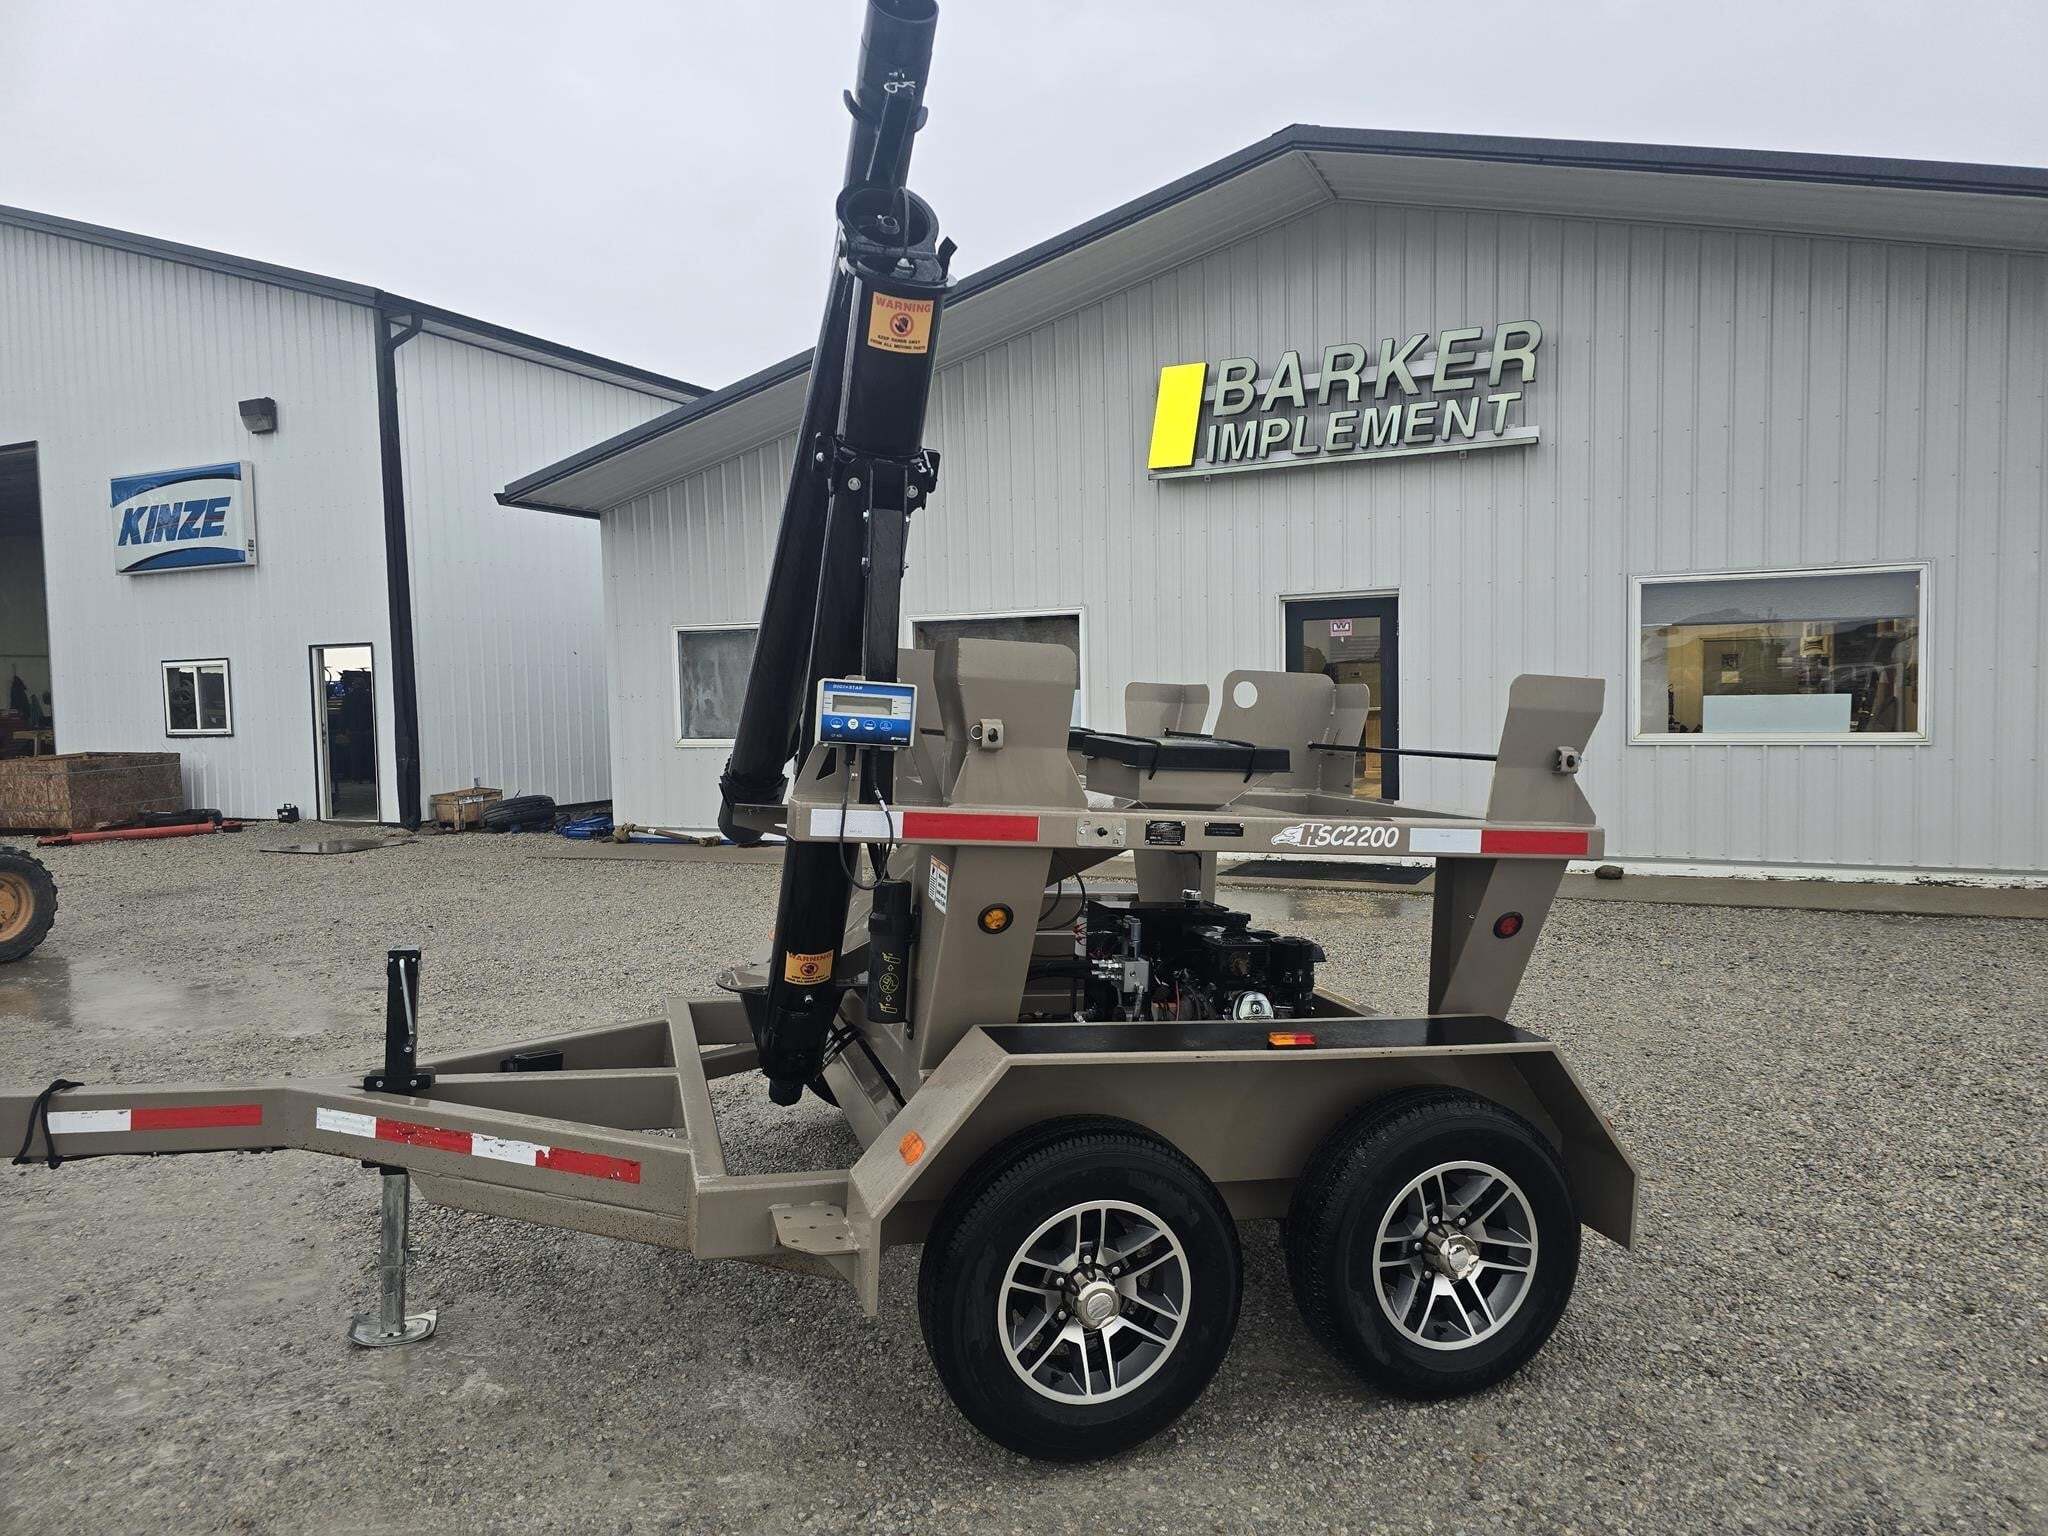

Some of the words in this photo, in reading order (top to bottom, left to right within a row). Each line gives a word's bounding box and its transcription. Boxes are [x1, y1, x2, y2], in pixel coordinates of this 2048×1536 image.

[875, 295, 931, 313] WARNING
[1212, 319, 1543, 417] BARKER
[1206, 391, 1522, 464] IMPLEMENT
[118, 496, 231, 547] KINZE
[789, 952, 833, 962] WARNING
